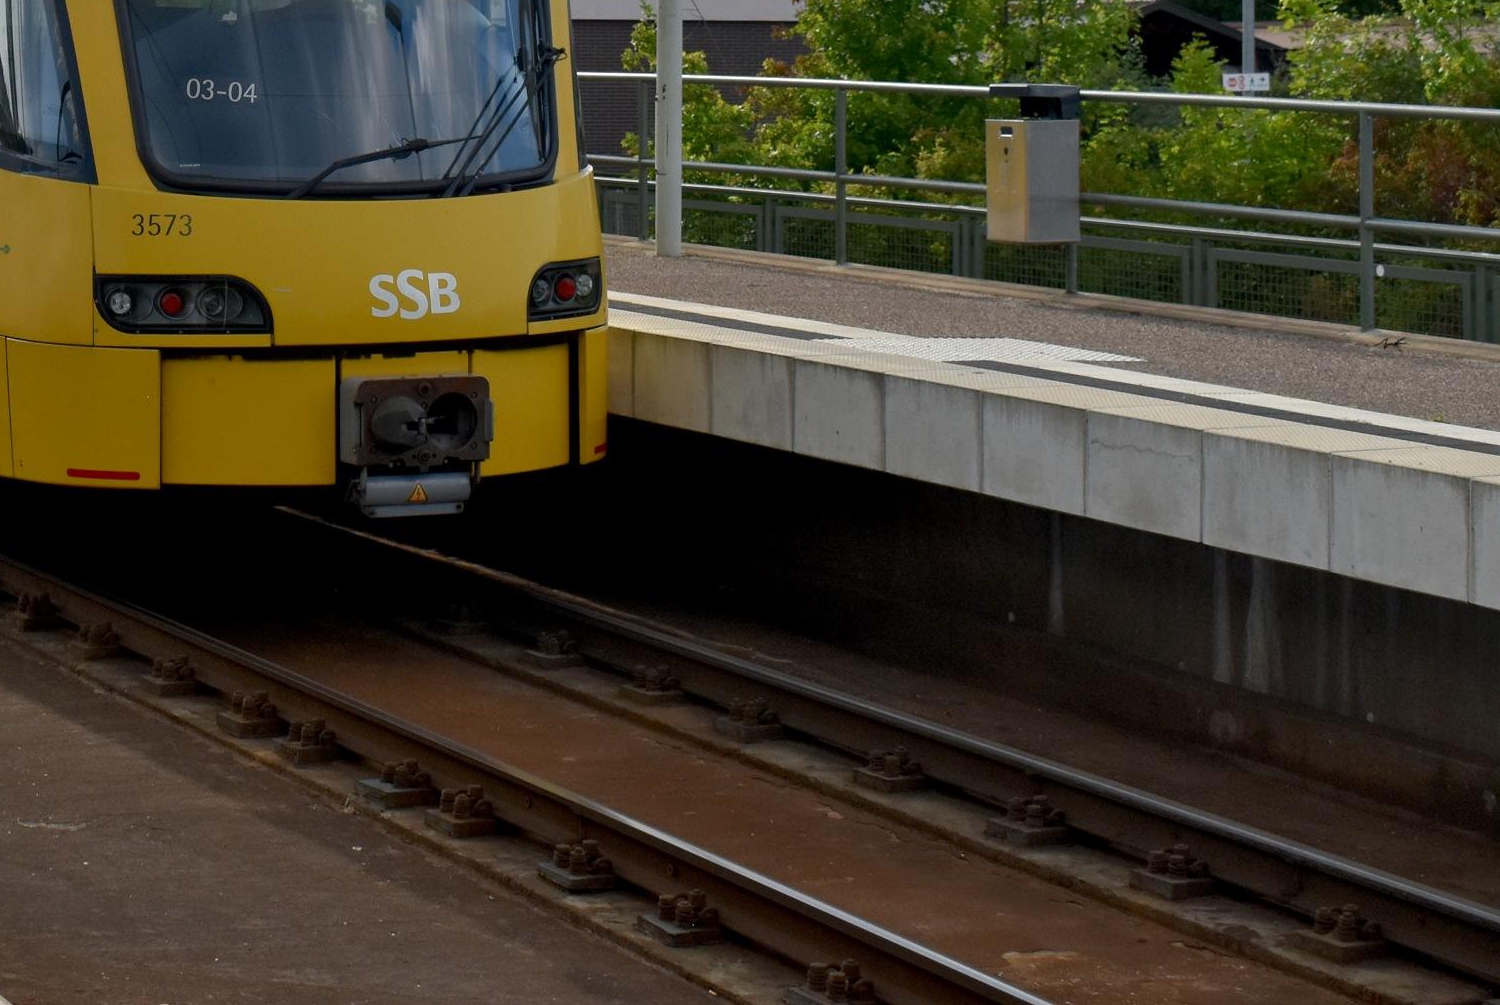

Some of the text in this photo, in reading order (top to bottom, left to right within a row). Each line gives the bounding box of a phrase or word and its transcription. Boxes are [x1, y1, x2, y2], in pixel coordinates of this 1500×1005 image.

[186, 78, 258, 104] 03-04
[131, 213, 193, 237] 3573
[368, 269, 461, 320] SSB
